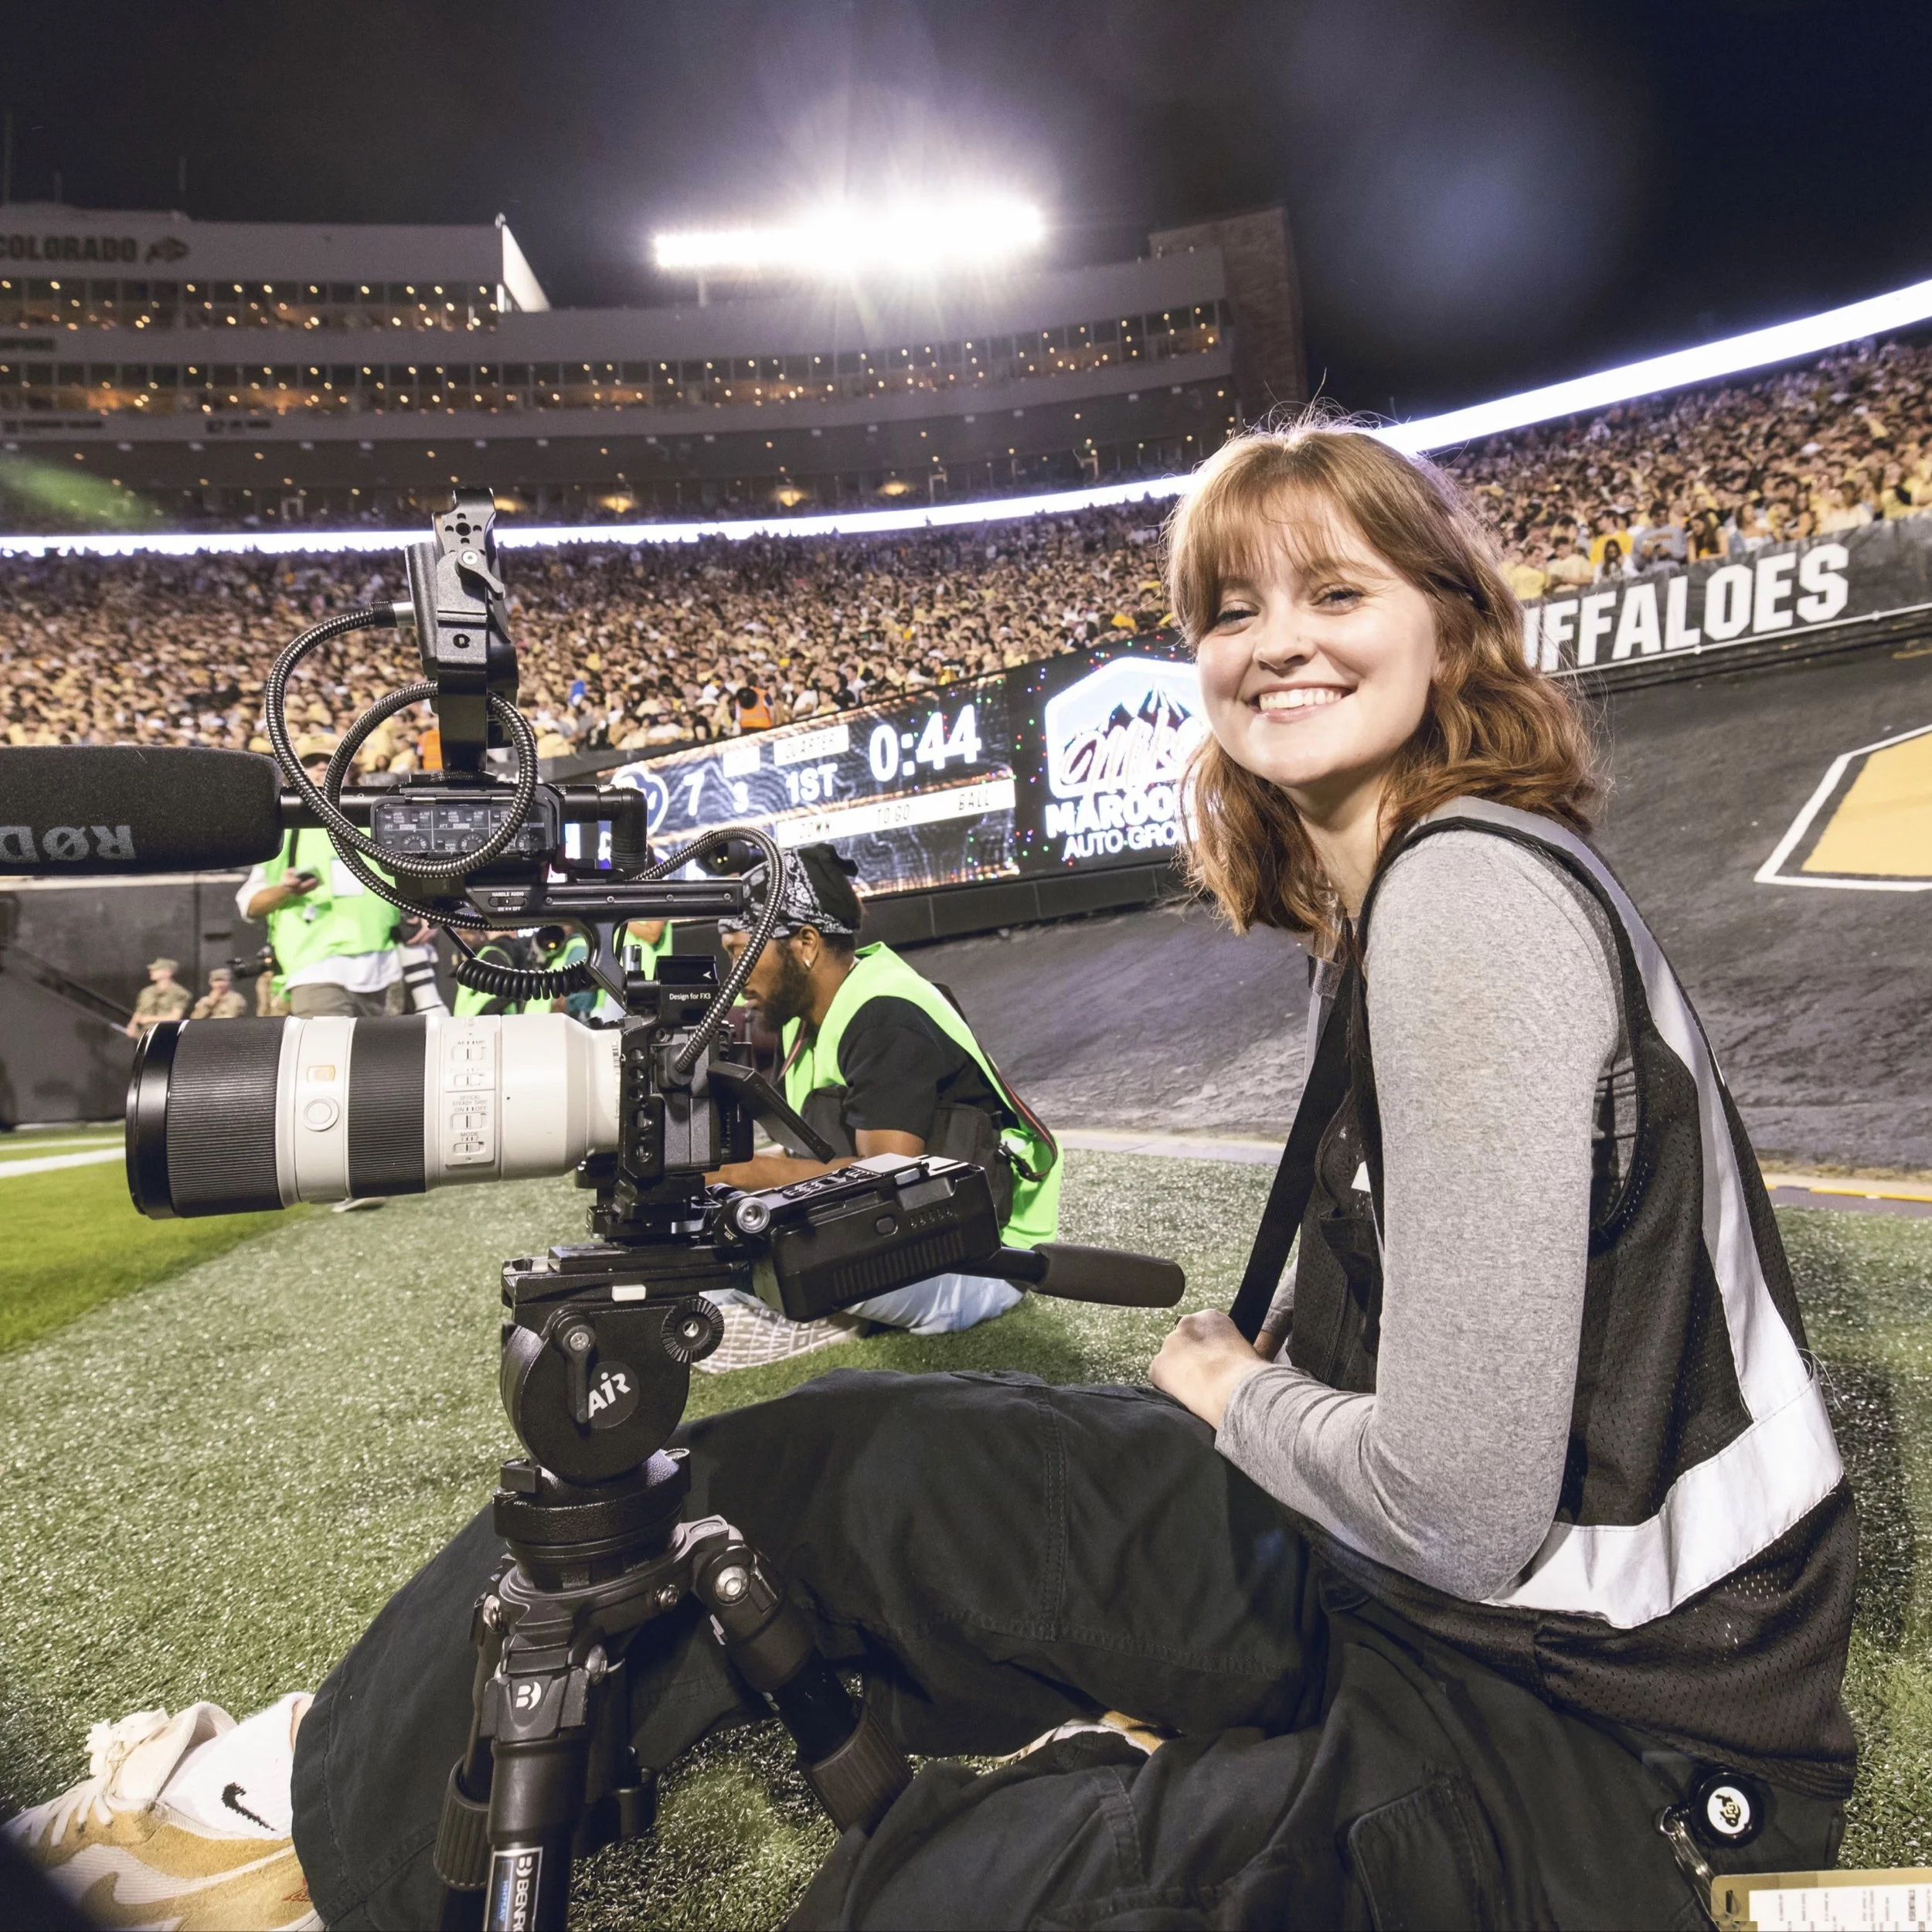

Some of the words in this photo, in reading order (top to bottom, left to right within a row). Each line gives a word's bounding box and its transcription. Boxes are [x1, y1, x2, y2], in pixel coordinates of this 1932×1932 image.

[869, 704, 981, 782] 0:44
[683, 770, 705, 816] 7
[785, 763, 838, 804] 1ST
[959, 788, 989, 811] BALL
[877, 808, 890, 825] TO
[894, 804, 910, 821] GO
[1045, 783, 1187, 838] MAROO
[1063, 829, 1124, 859] AUTO
[1127, 821, 1186, 851] GRO
